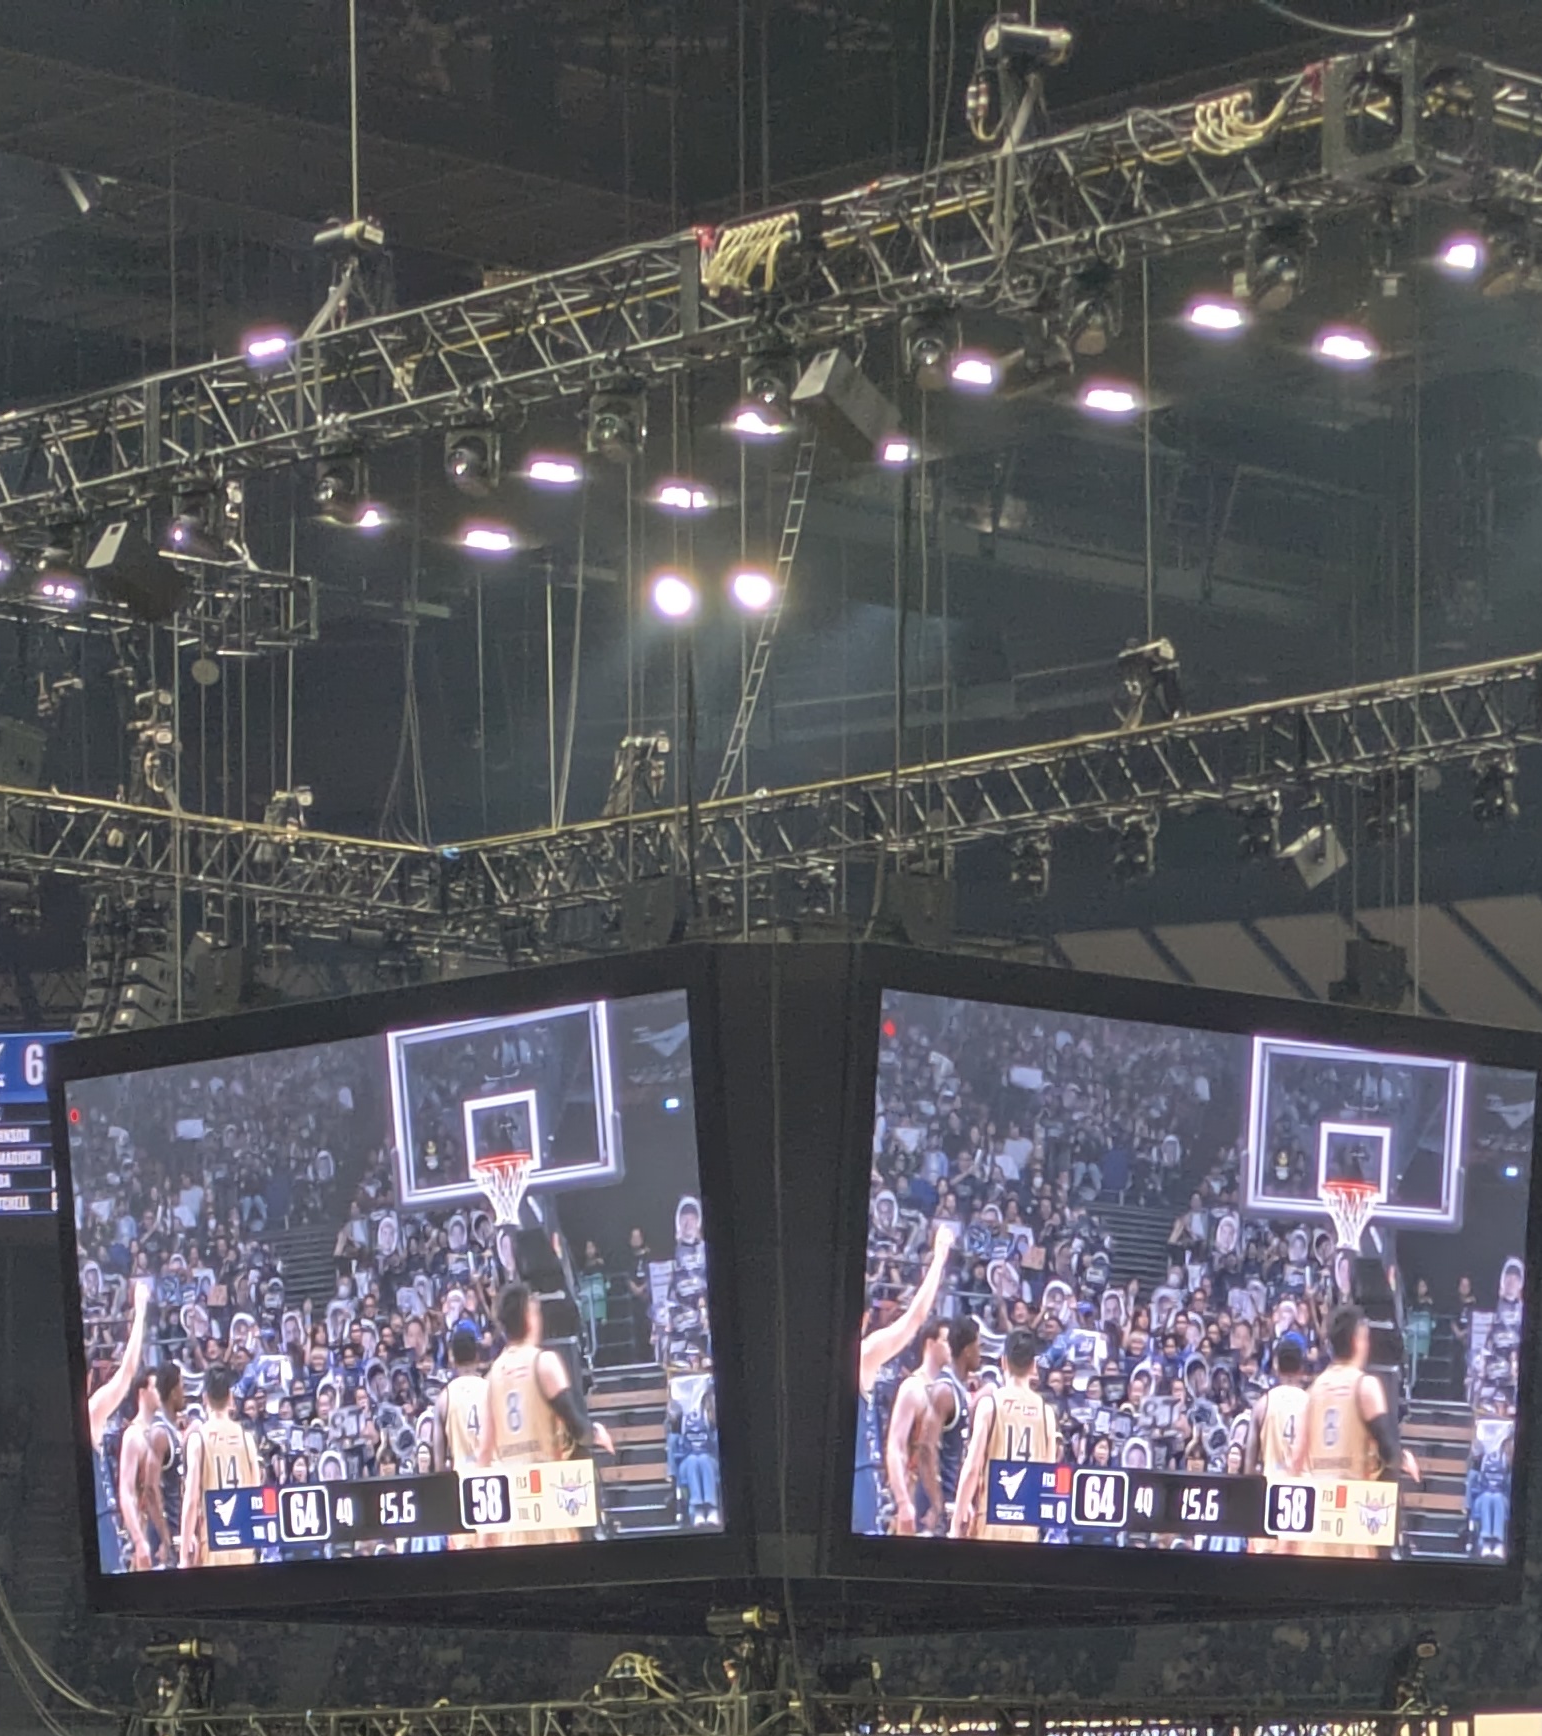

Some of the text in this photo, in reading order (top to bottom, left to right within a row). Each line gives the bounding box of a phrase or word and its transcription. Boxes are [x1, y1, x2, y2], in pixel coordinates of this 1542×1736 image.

[290, 1491, 321, 1535] 64
[471, 1477, 503, 1522] 58
[1084, 1475, 1116, 1521] 64
[1181, 1487, 1219, 1521] 15.6
[1276, 1486, 1308, 1531] 58
